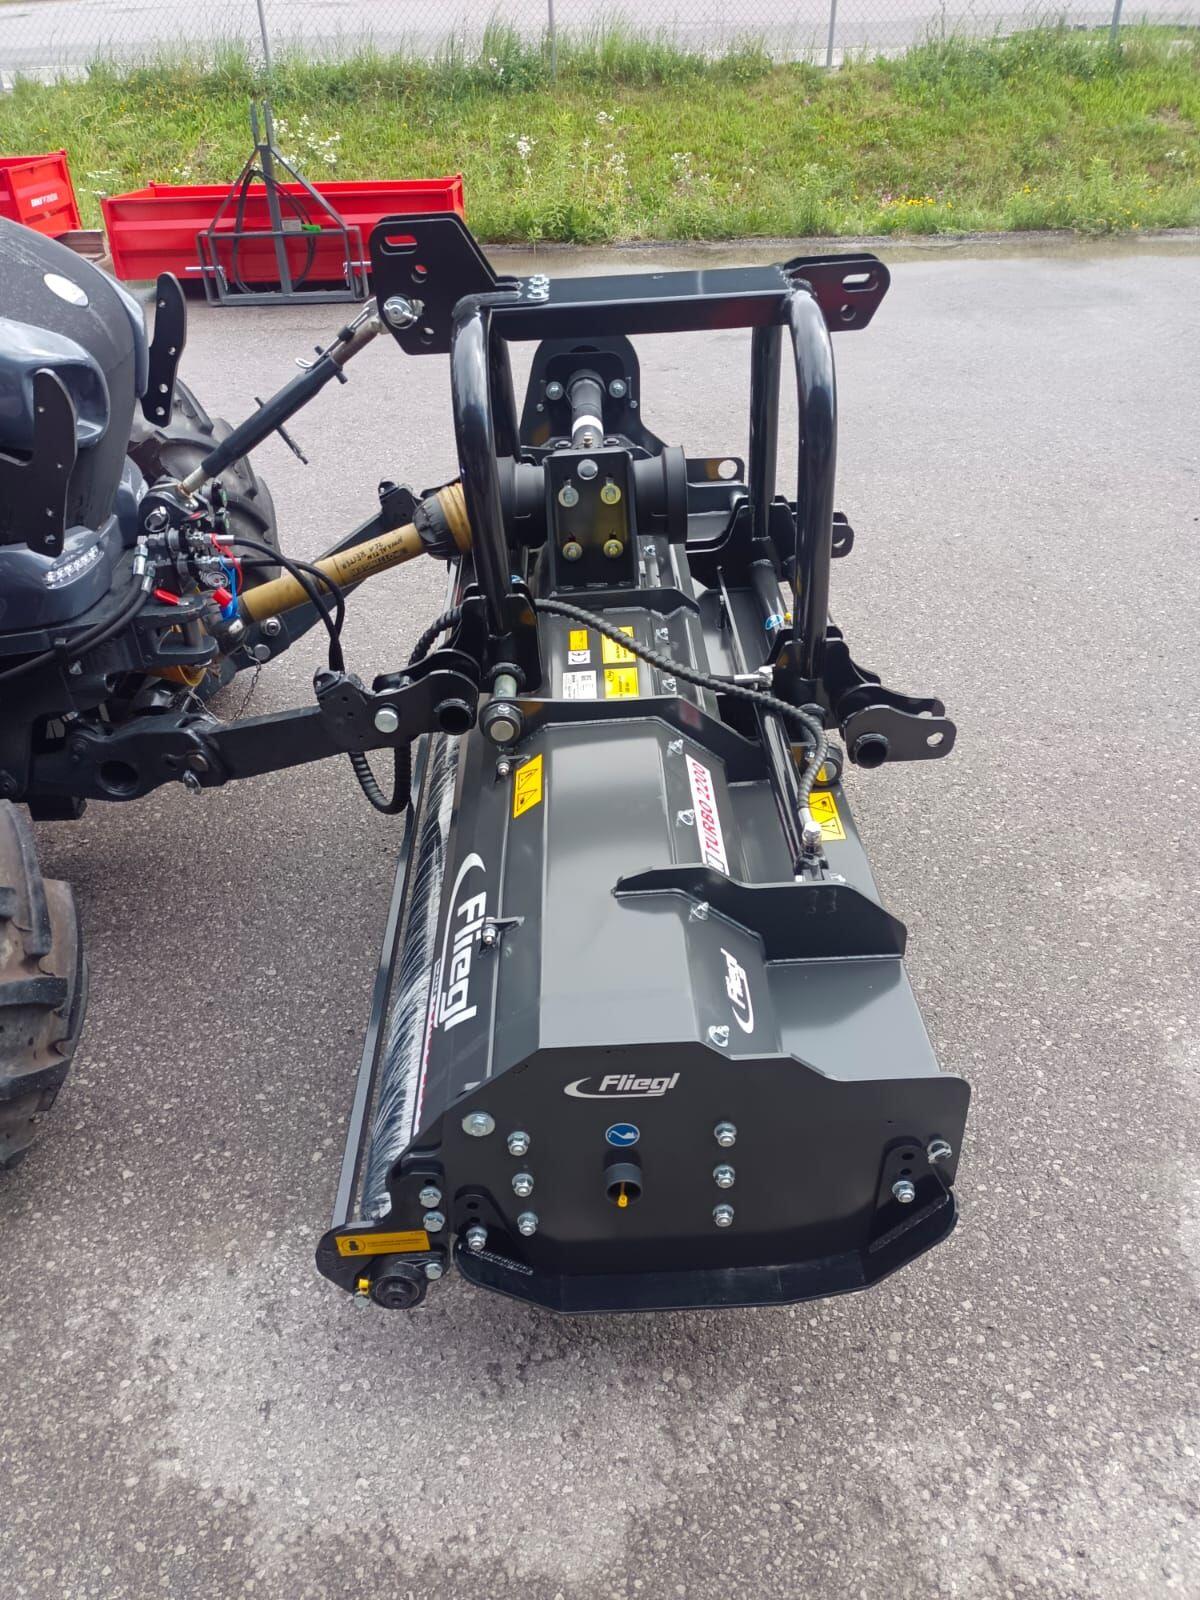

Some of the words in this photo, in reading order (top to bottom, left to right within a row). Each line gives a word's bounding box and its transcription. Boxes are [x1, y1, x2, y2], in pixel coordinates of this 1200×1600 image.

[692, 762, 710, 800] 2200
[699, 799, 720, 854] TURBO
[439, 891, 487, 1032] Fliegl
[598, 1072, 681, 1094] Fliegl
